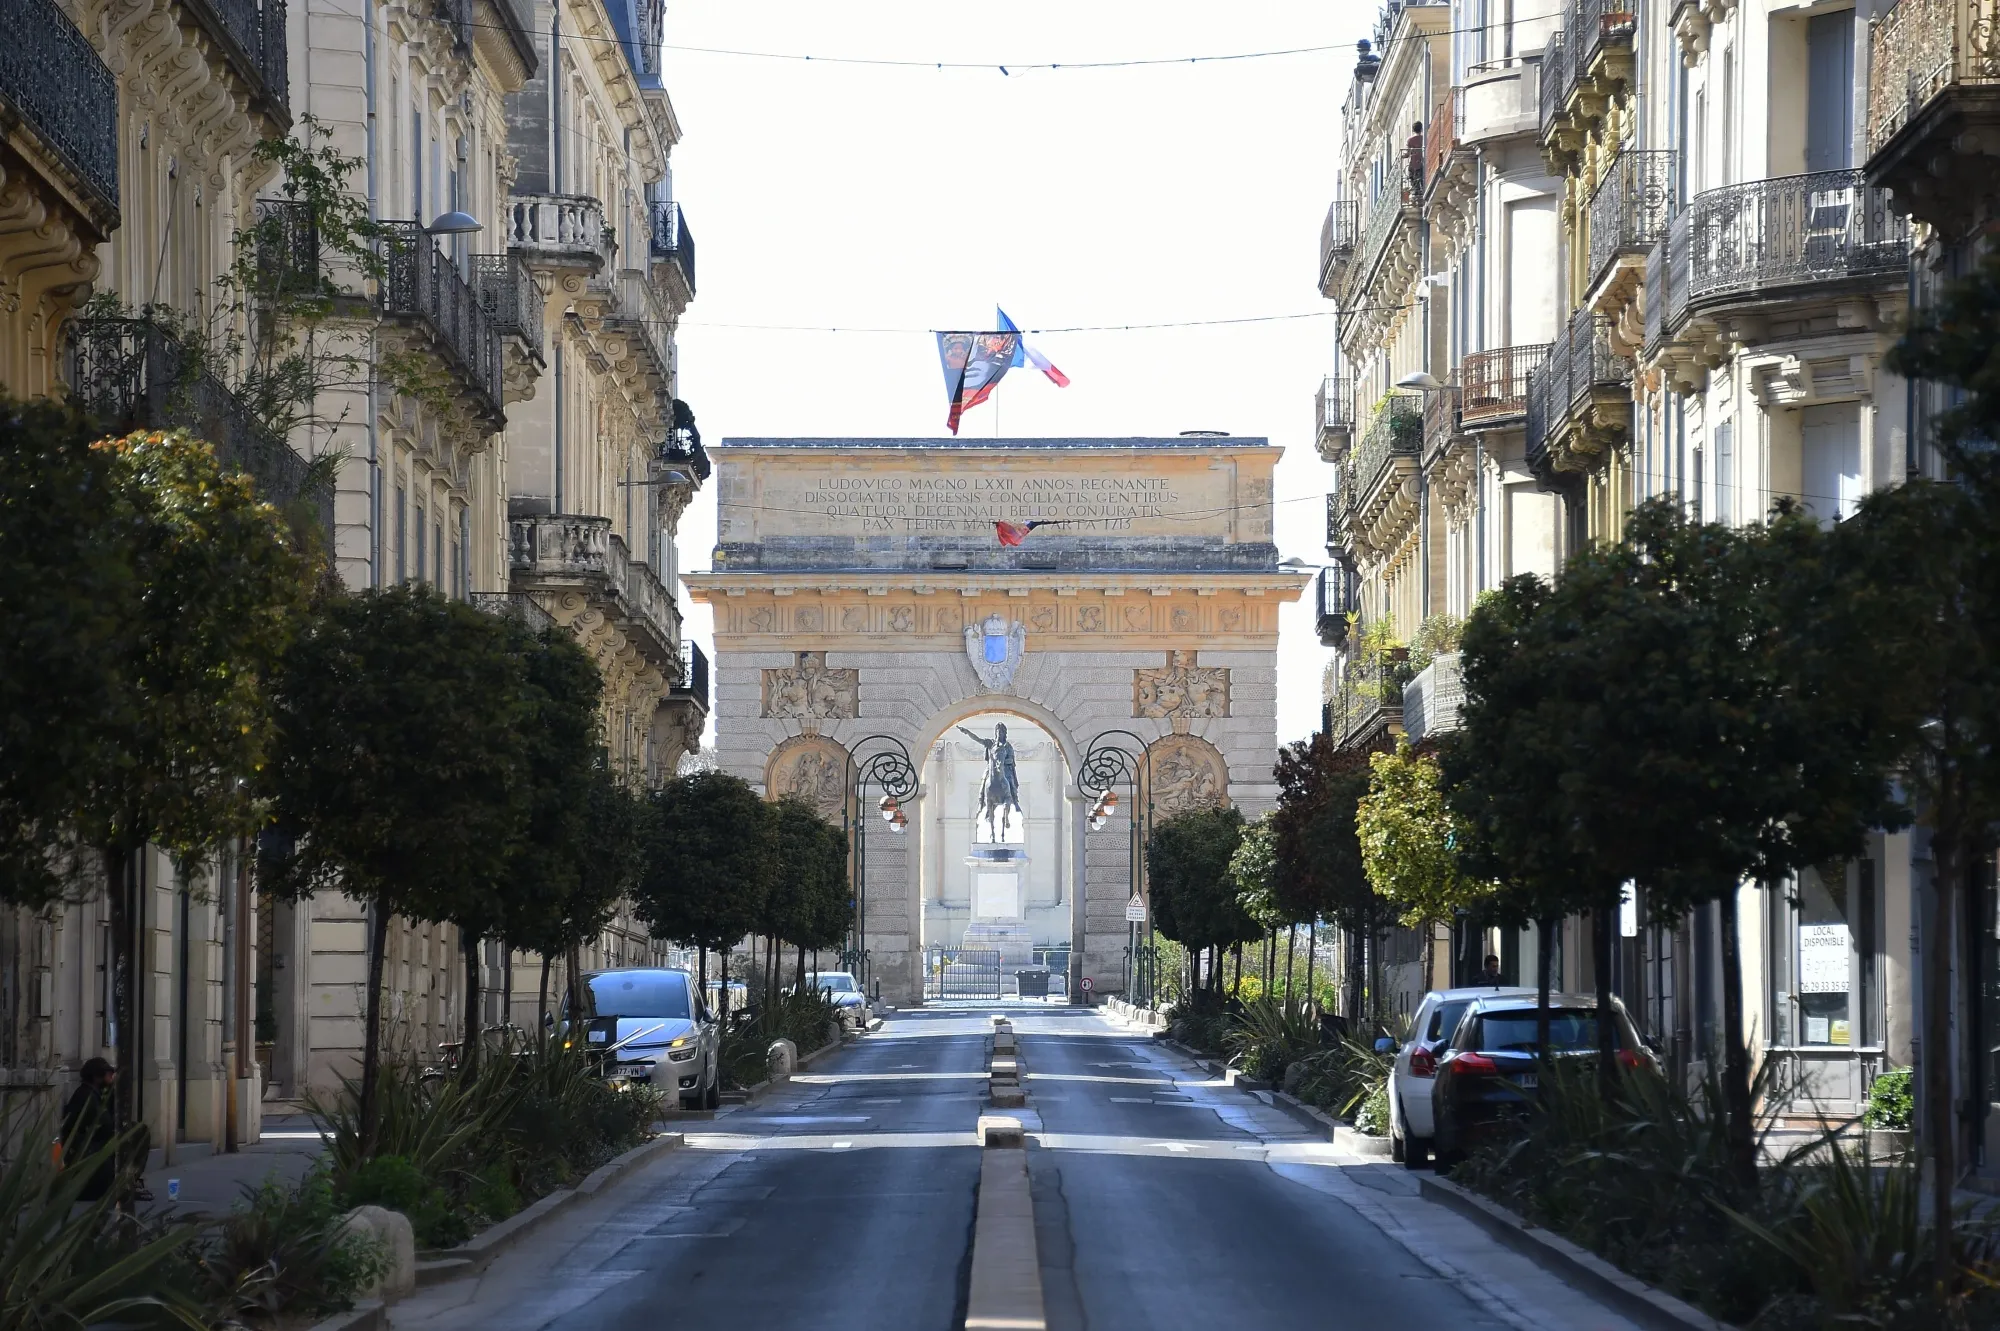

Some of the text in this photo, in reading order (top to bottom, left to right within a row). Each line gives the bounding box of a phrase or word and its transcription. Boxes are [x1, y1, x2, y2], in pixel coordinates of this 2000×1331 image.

[819, 478, 1169, 490] LUDOVICO MAGNO LXXII ANNOS REGNANTE
[805, 491, 900, 503] DISSOCIATIS
[907, 491, 981, 503] REPRESSIS
[1096, 491, 1178, 503] GENTIBUS
[826, 505, 1162, 519] QUATUOR DECENNALI BELLO CONJURATIS
[863, 518, 894, 530] PAX
[905, 518, 956, 530] TERRA
[1813, 926, 1835, 936] LOCAL
[1804, 937, 1844, 947] DISPONIBLE
[1811, 981, 1820, 992] 29
[1821, 981, 1830, 992] 33
[1831, 981, 1840, 991] 35
[1841, 981, 1850, 991] 92
